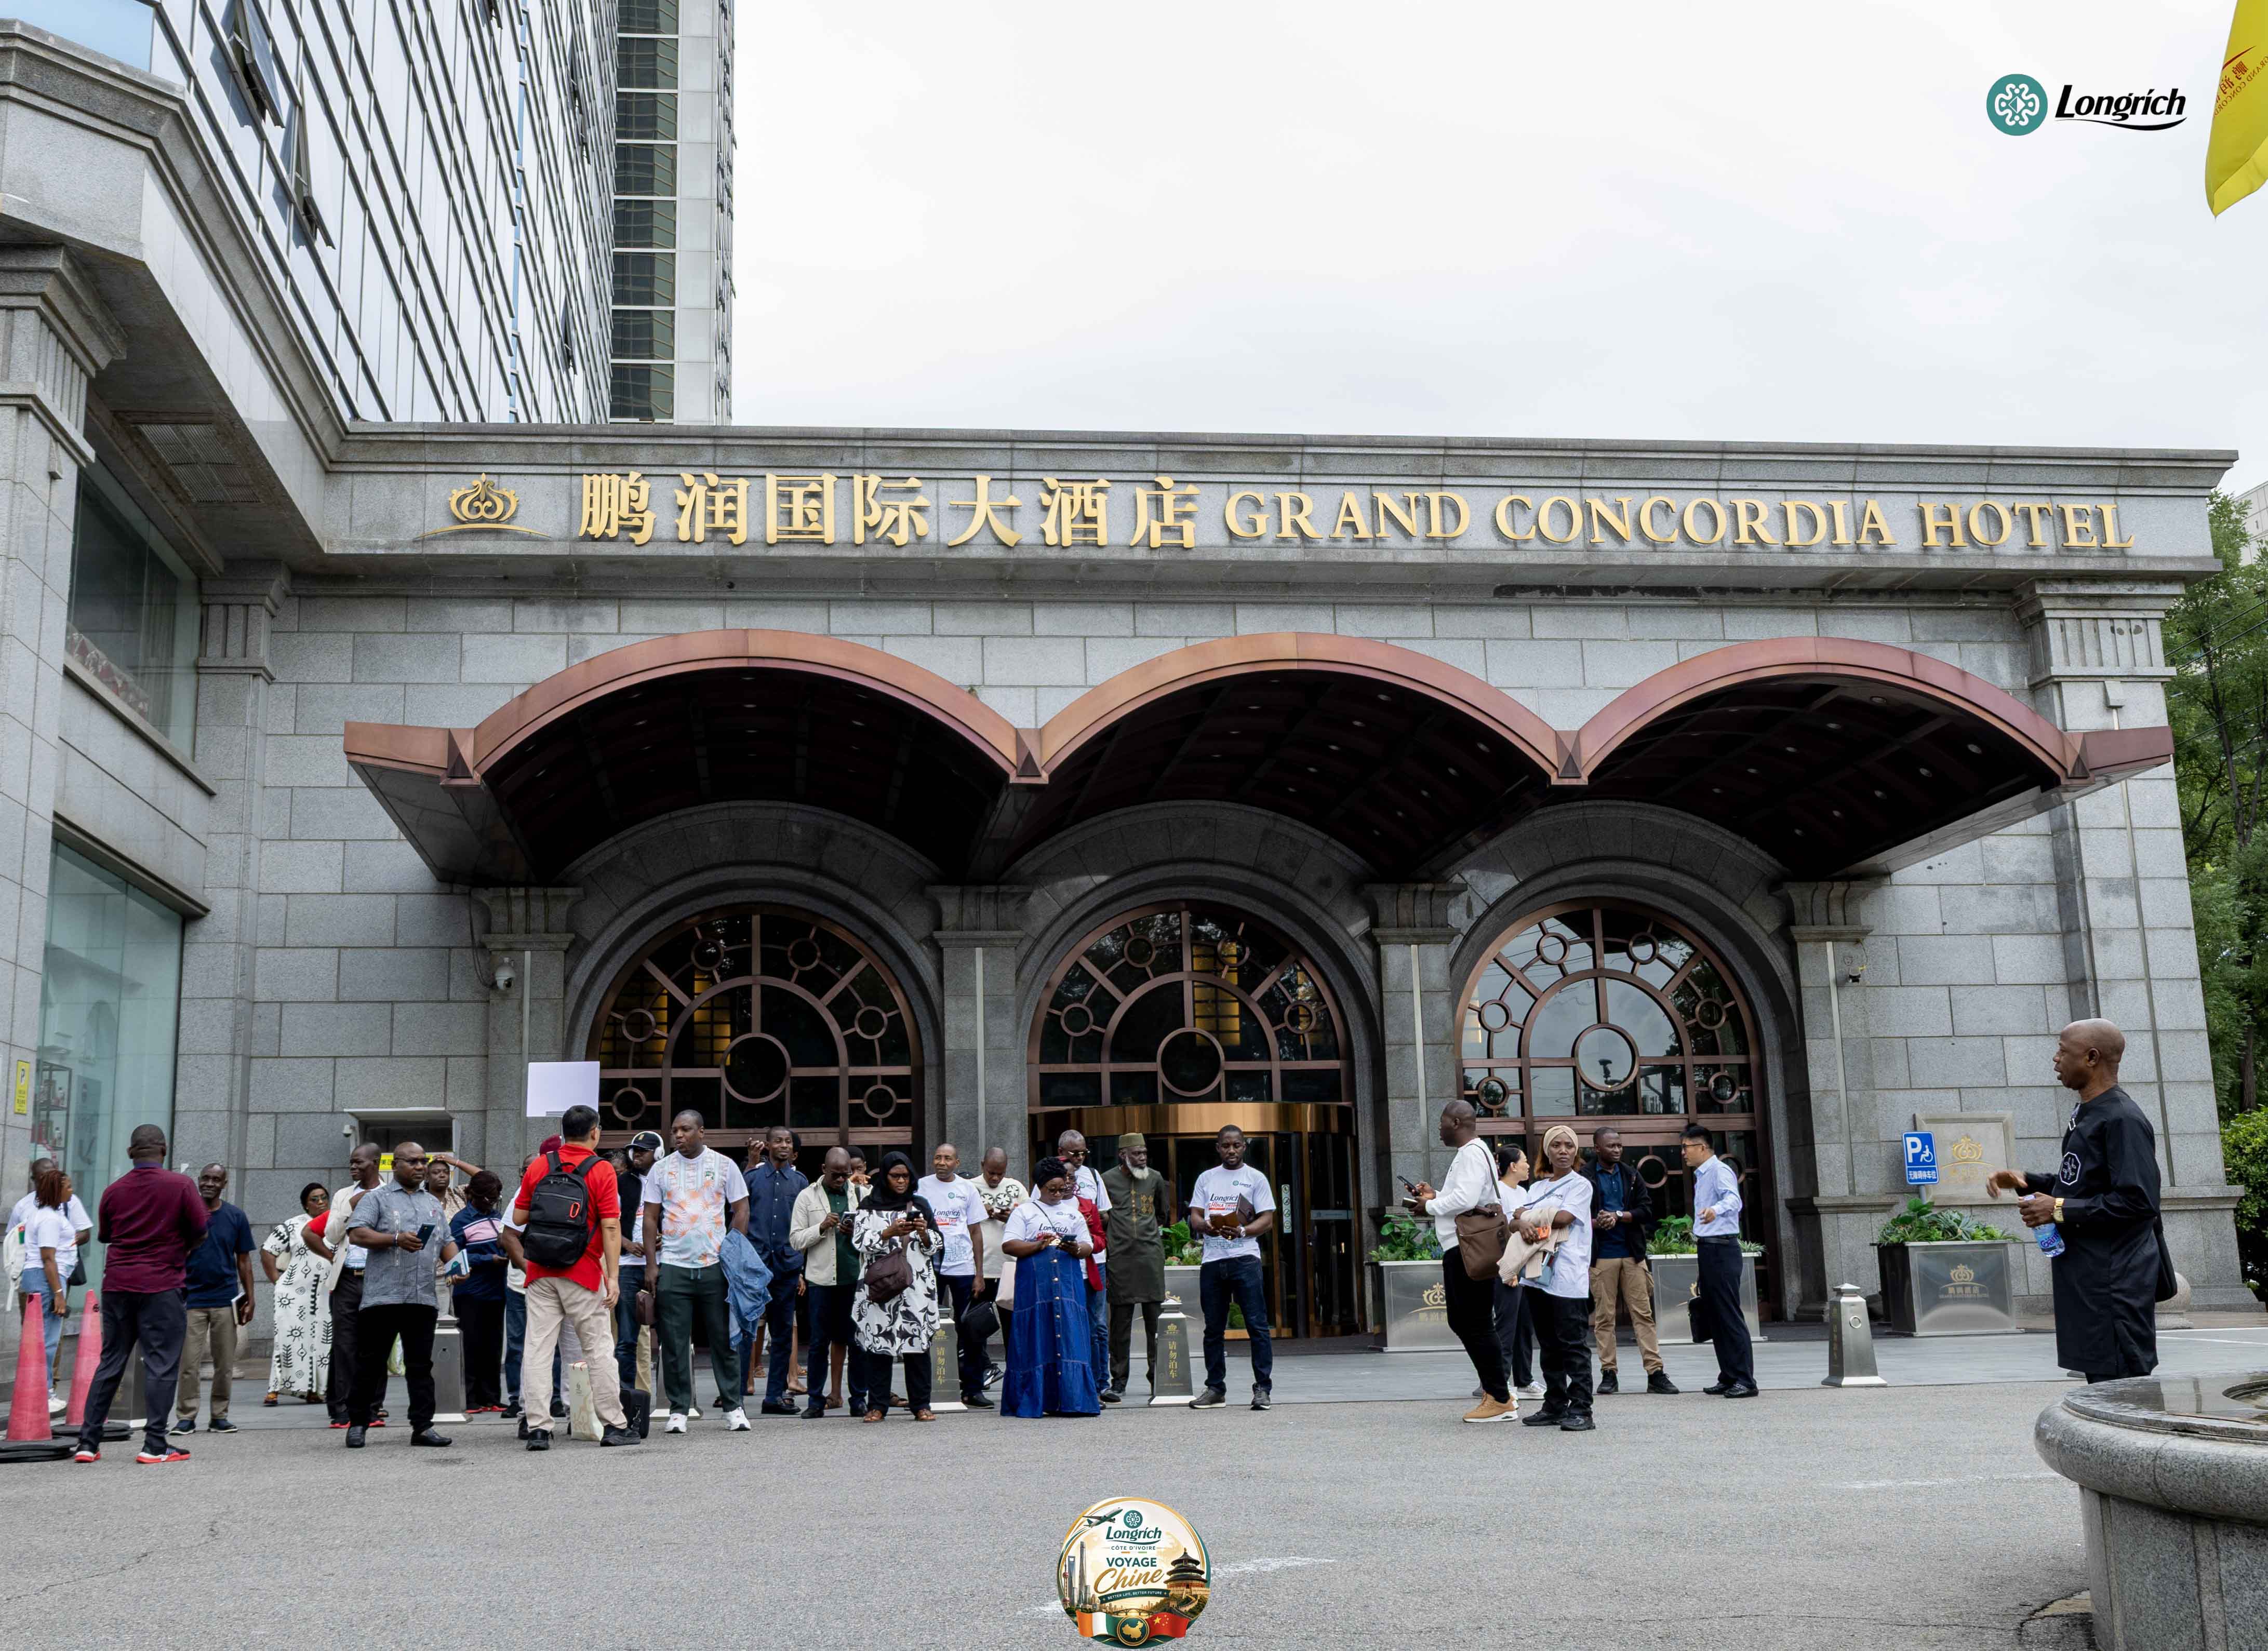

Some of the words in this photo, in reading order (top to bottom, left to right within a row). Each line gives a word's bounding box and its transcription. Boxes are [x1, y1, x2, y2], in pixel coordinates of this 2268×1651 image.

[578, 471, 1201, 549] 鹏润国际大酒店
[1224, 490, 1471, 539] GRAND
[1495, 494, 1898, 547] CONCORDIA
[1917, 500, 2136, 549] HOTEL
[1905, 1137, 1922, 1163] P
[1168, 1341, 1178, 1379] 请勿泊车
